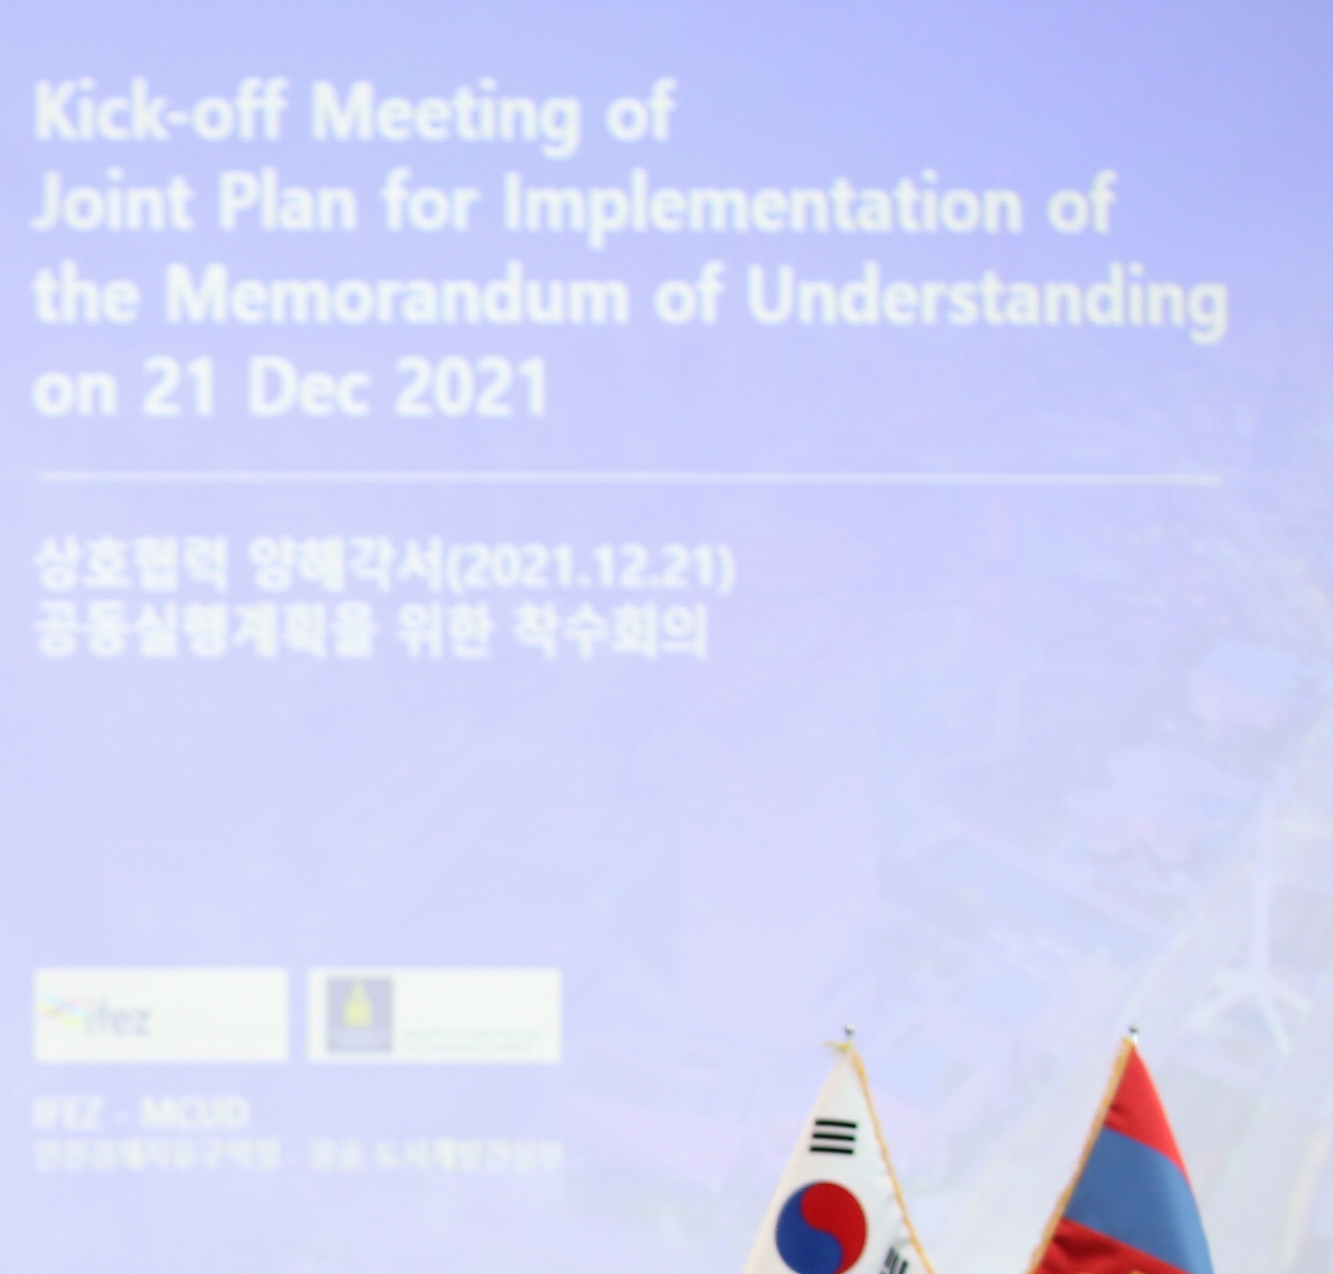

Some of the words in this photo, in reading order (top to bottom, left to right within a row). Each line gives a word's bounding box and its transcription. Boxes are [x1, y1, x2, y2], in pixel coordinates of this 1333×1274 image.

[33, 76, 291, 142] Kick-off
[310, 76, 583, 160] Meeting
[605, 76, 679, 142] of
[30, 166, 195, 232] Joint
[218, 166, 359, 232] Plan
[380, 166, 482, 233] for
[503, 167, 1025, 249] Implementation
[1046, 168, 1120, 235] of
[30, 259, 142, 325] the
[165, 259, 632, 325] Memorandum
[653, 259, 727, 326] of
[747, 260, 1231, 346] Understanding
[31, 370, 119, 418] on
[141, 354, 215, 418] 21
[247, 354, 372, 418] Dec
[394, 354, 548, 418] 2021
